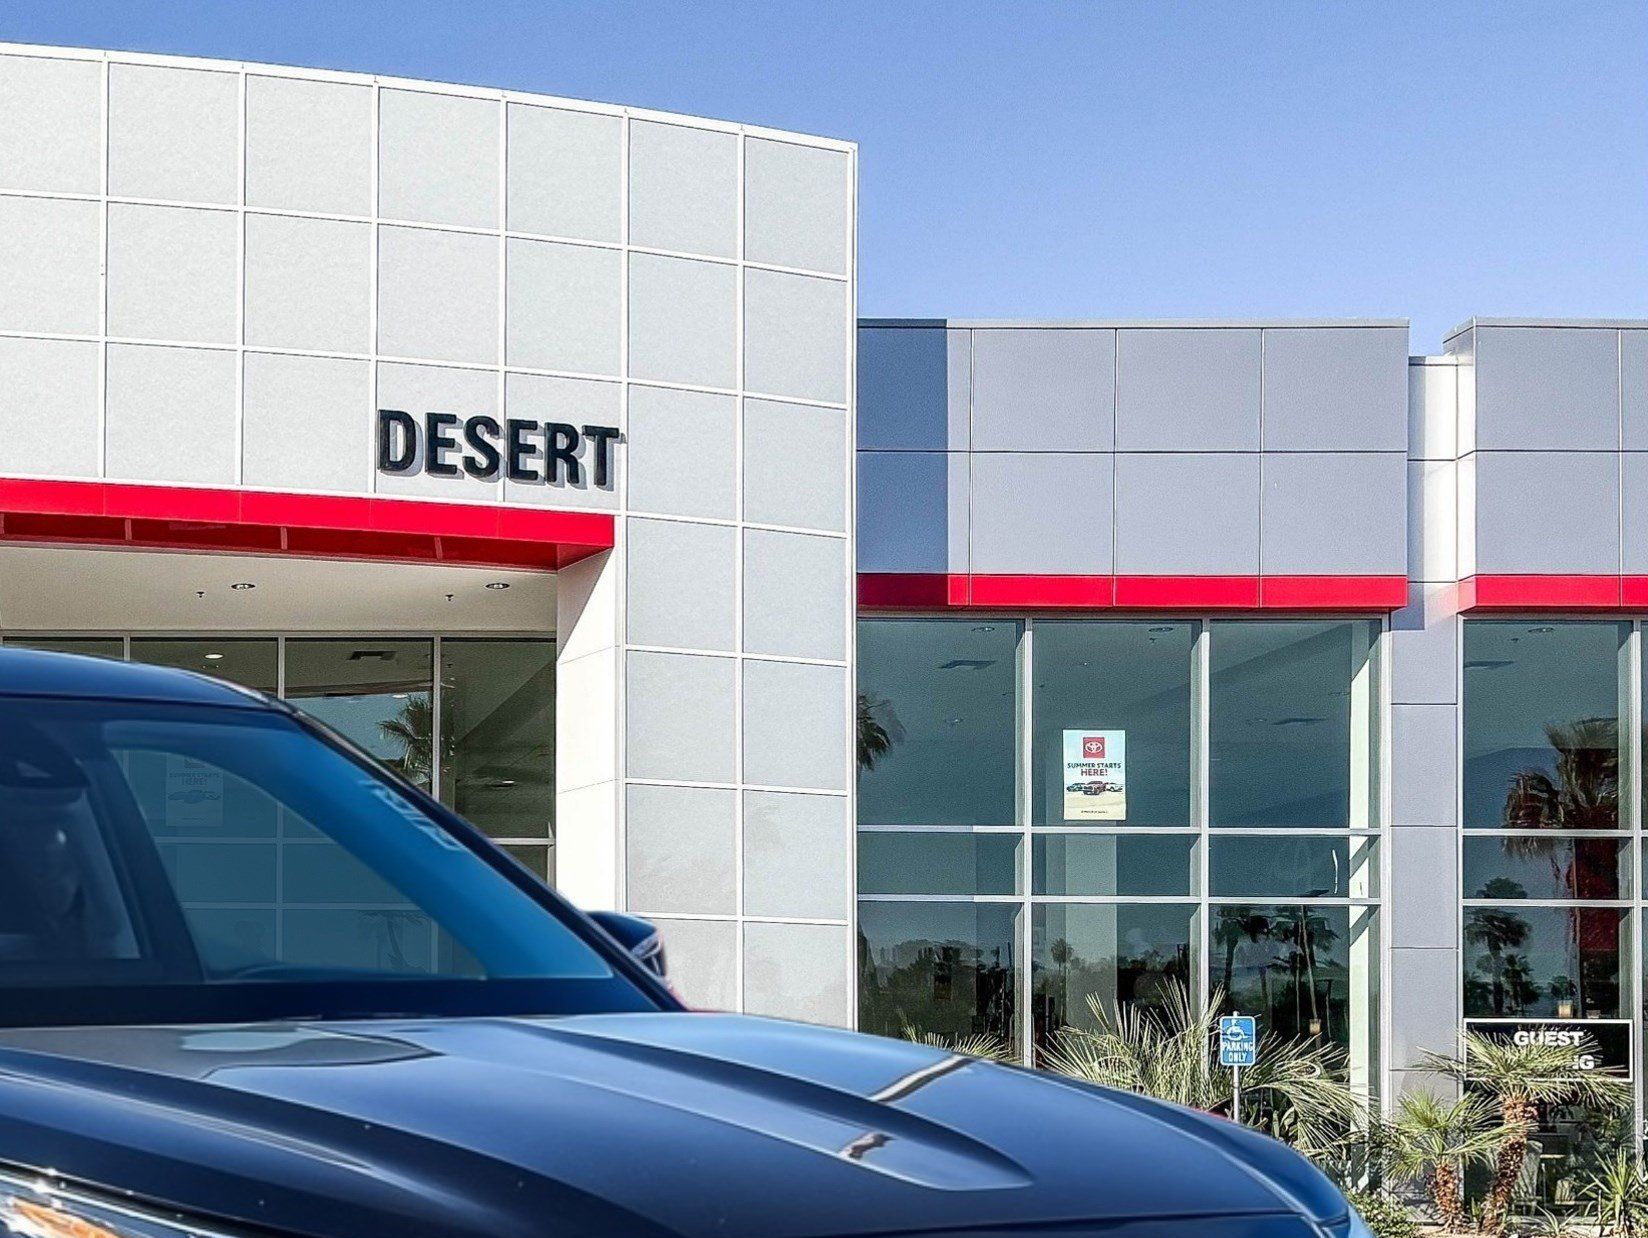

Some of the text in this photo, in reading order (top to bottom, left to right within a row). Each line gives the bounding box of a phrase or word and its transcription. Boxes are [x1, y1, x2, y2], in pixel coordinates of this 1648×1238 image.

[376, 408, 621, 487] DESERT
[1081, 769, 1108, 777] HERE!
[1513, 1030, 1584, 1047] GUEST
[1222, 1041, 1253, 1051] PARKING
[1228, 1052, 1247, 1062] ONLY
